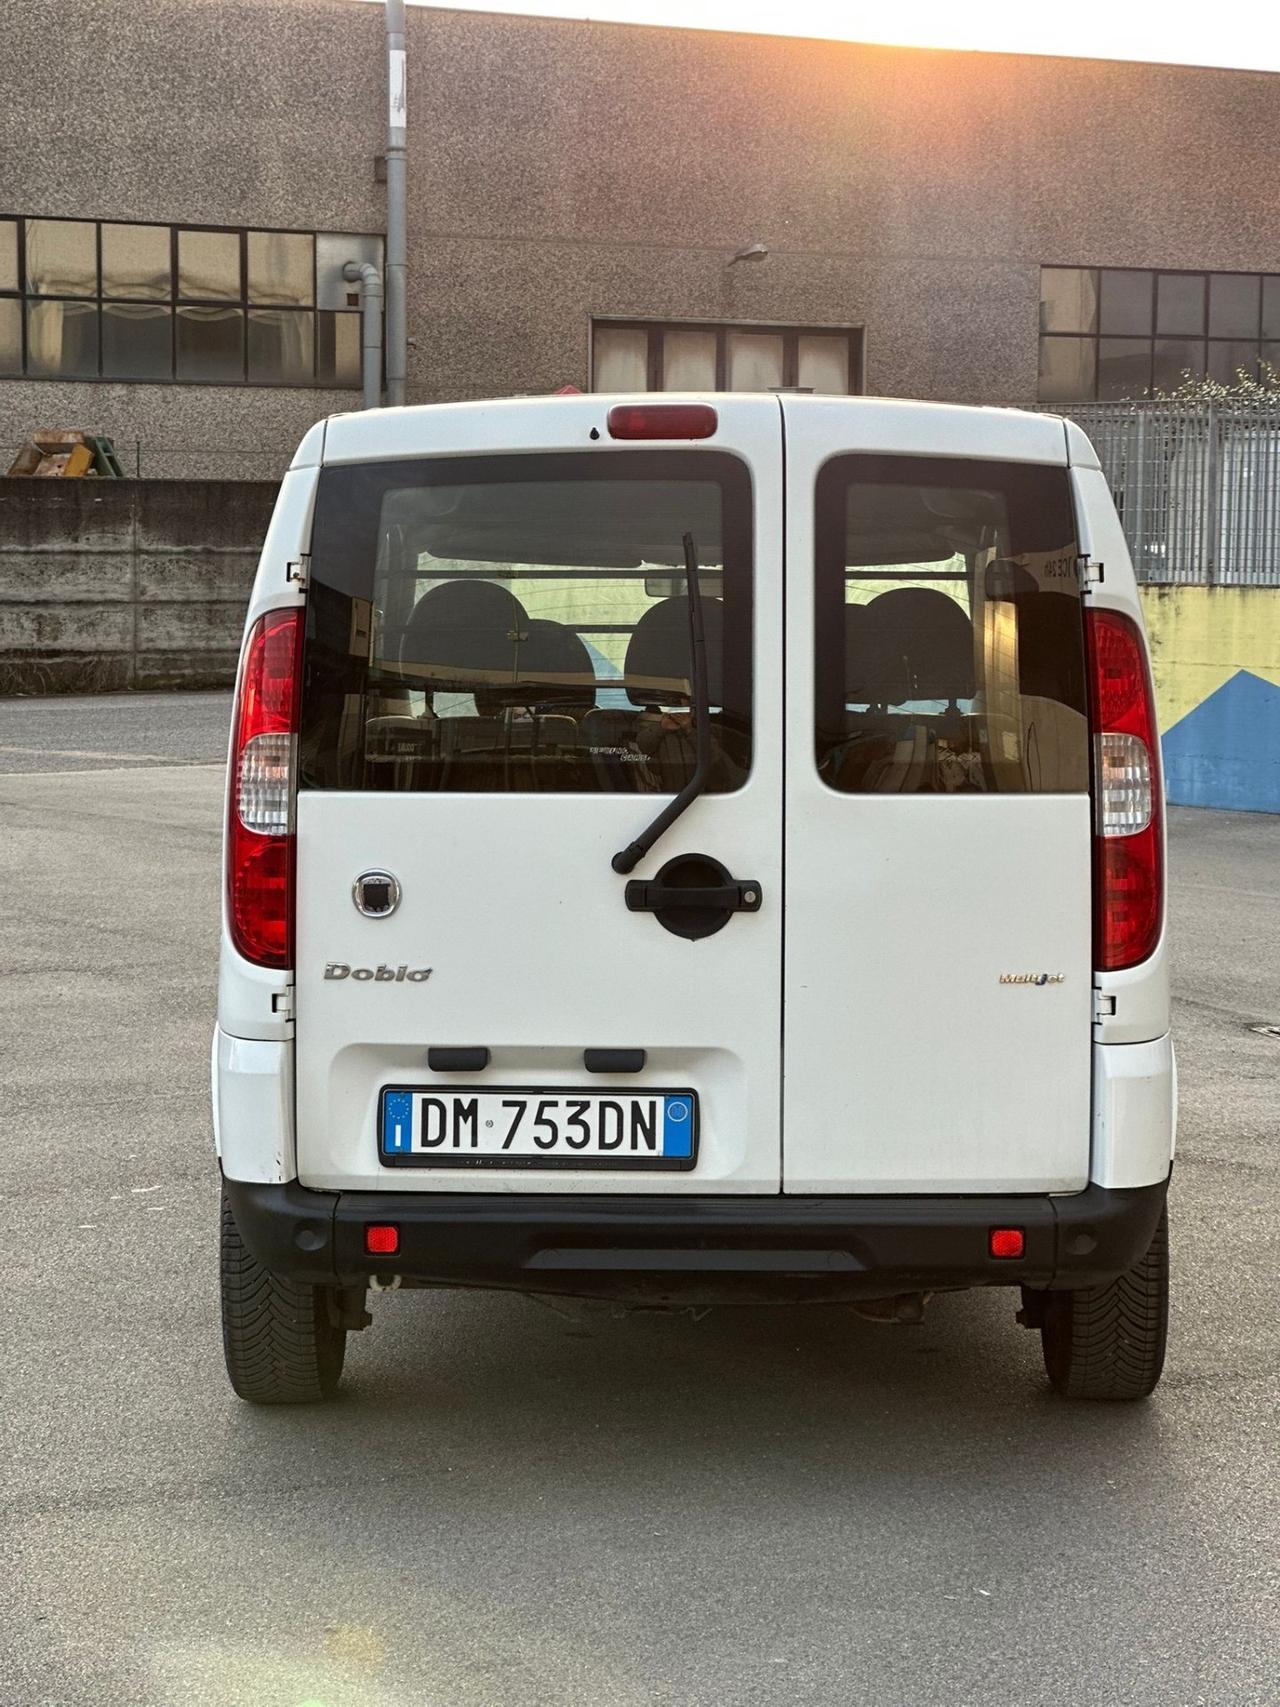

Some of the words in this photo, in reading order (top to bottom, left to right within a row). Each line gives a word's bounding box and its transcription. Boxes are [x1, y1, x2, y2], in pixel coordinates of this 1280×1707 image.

[394, 1124, 402, 1147] I
[421, 1098, 479, 1148] DM
[502, 1101, 657, 1150] 753DN
